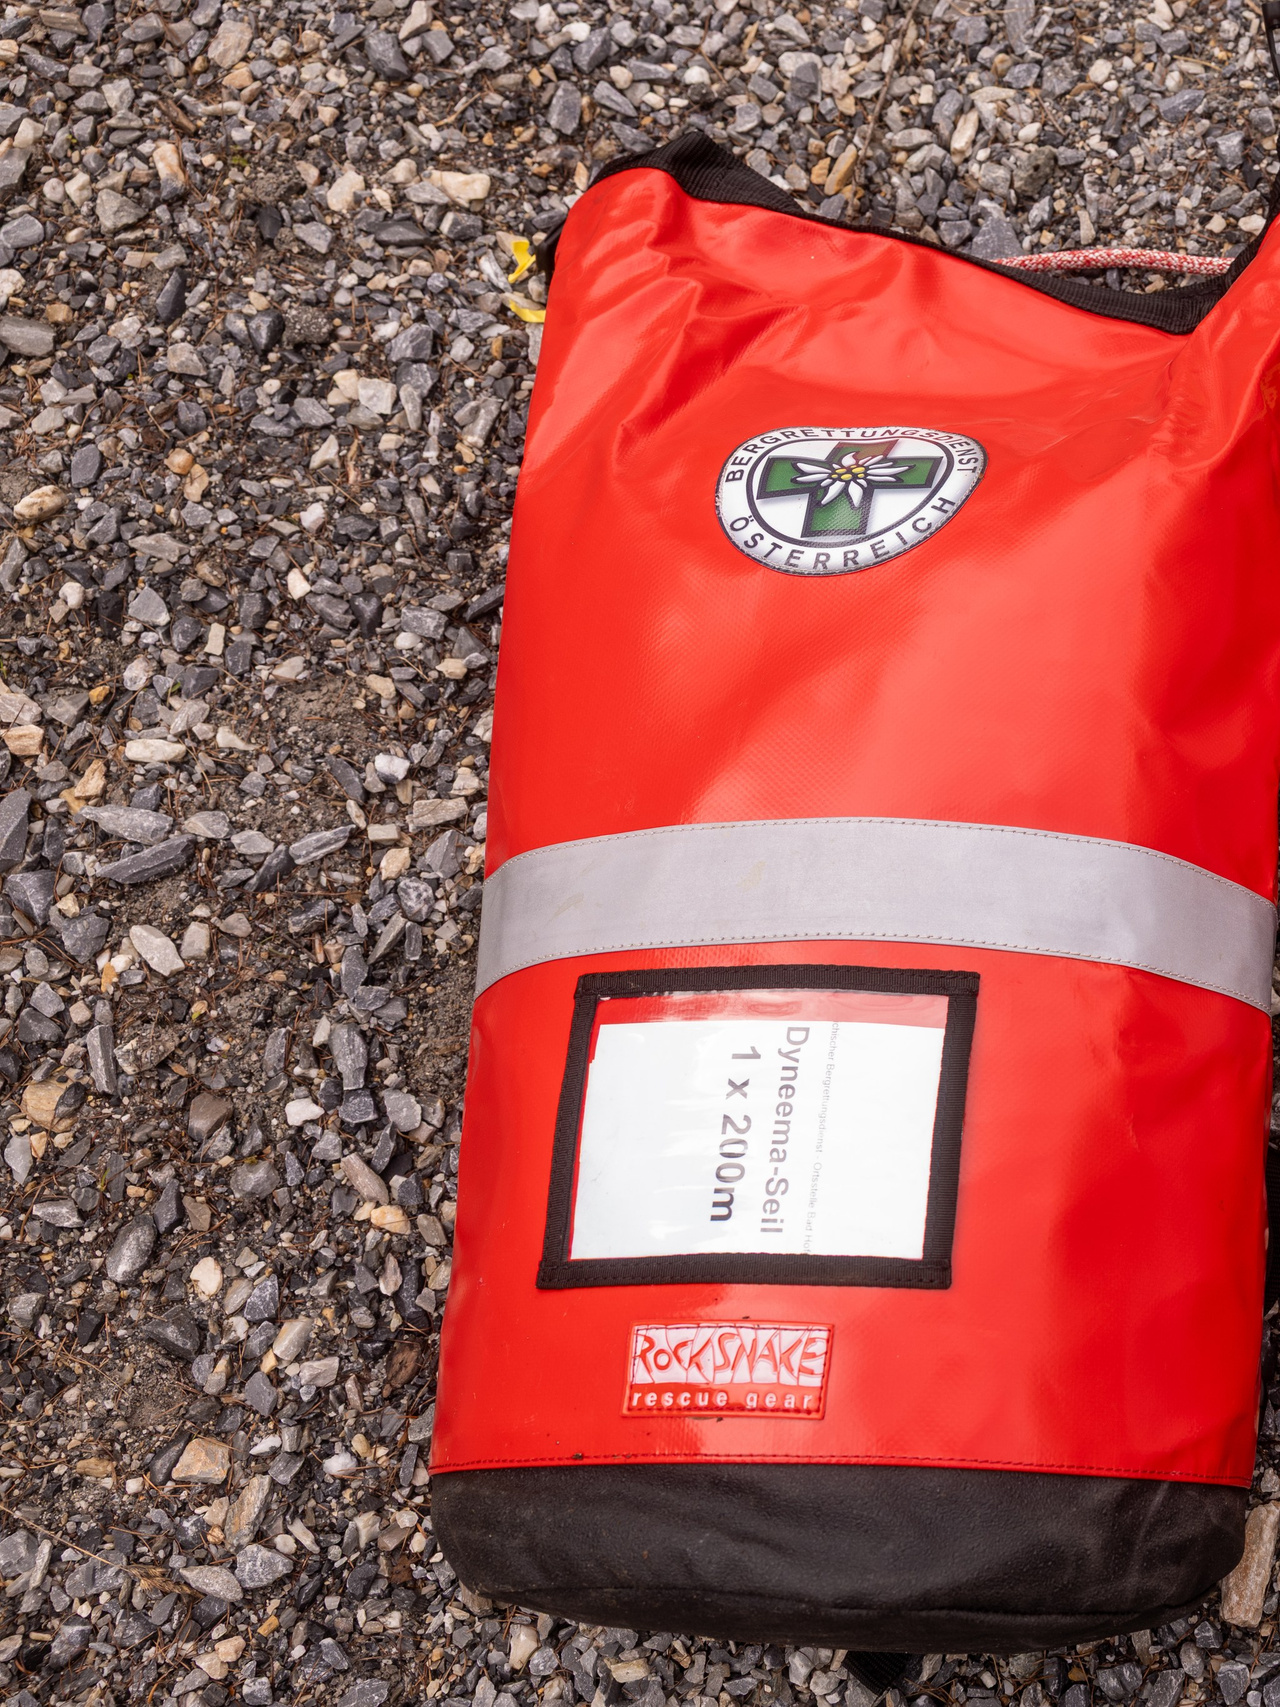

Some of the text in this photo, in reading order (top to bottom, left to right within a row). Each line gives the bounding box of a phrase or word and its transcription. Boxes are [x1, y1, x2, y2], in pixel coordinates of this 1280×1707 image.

[725, 428, 979, 483] BERGRETTUNGSDIENST
[729, 496, 956, 570] ÖSTERREICH
[710, 1046, 762, 1222] 1 x 200m
[760, 1026, 810, 1233] Dyneema-Seil
[814, 1063, 836, 1153] Bergrettungsdienst
[807, 1162, 823, 1208] Ortsstelle
[804, 1211, 816, 1231] Bad
[632, 1391, 814, 1409] rescue gear
